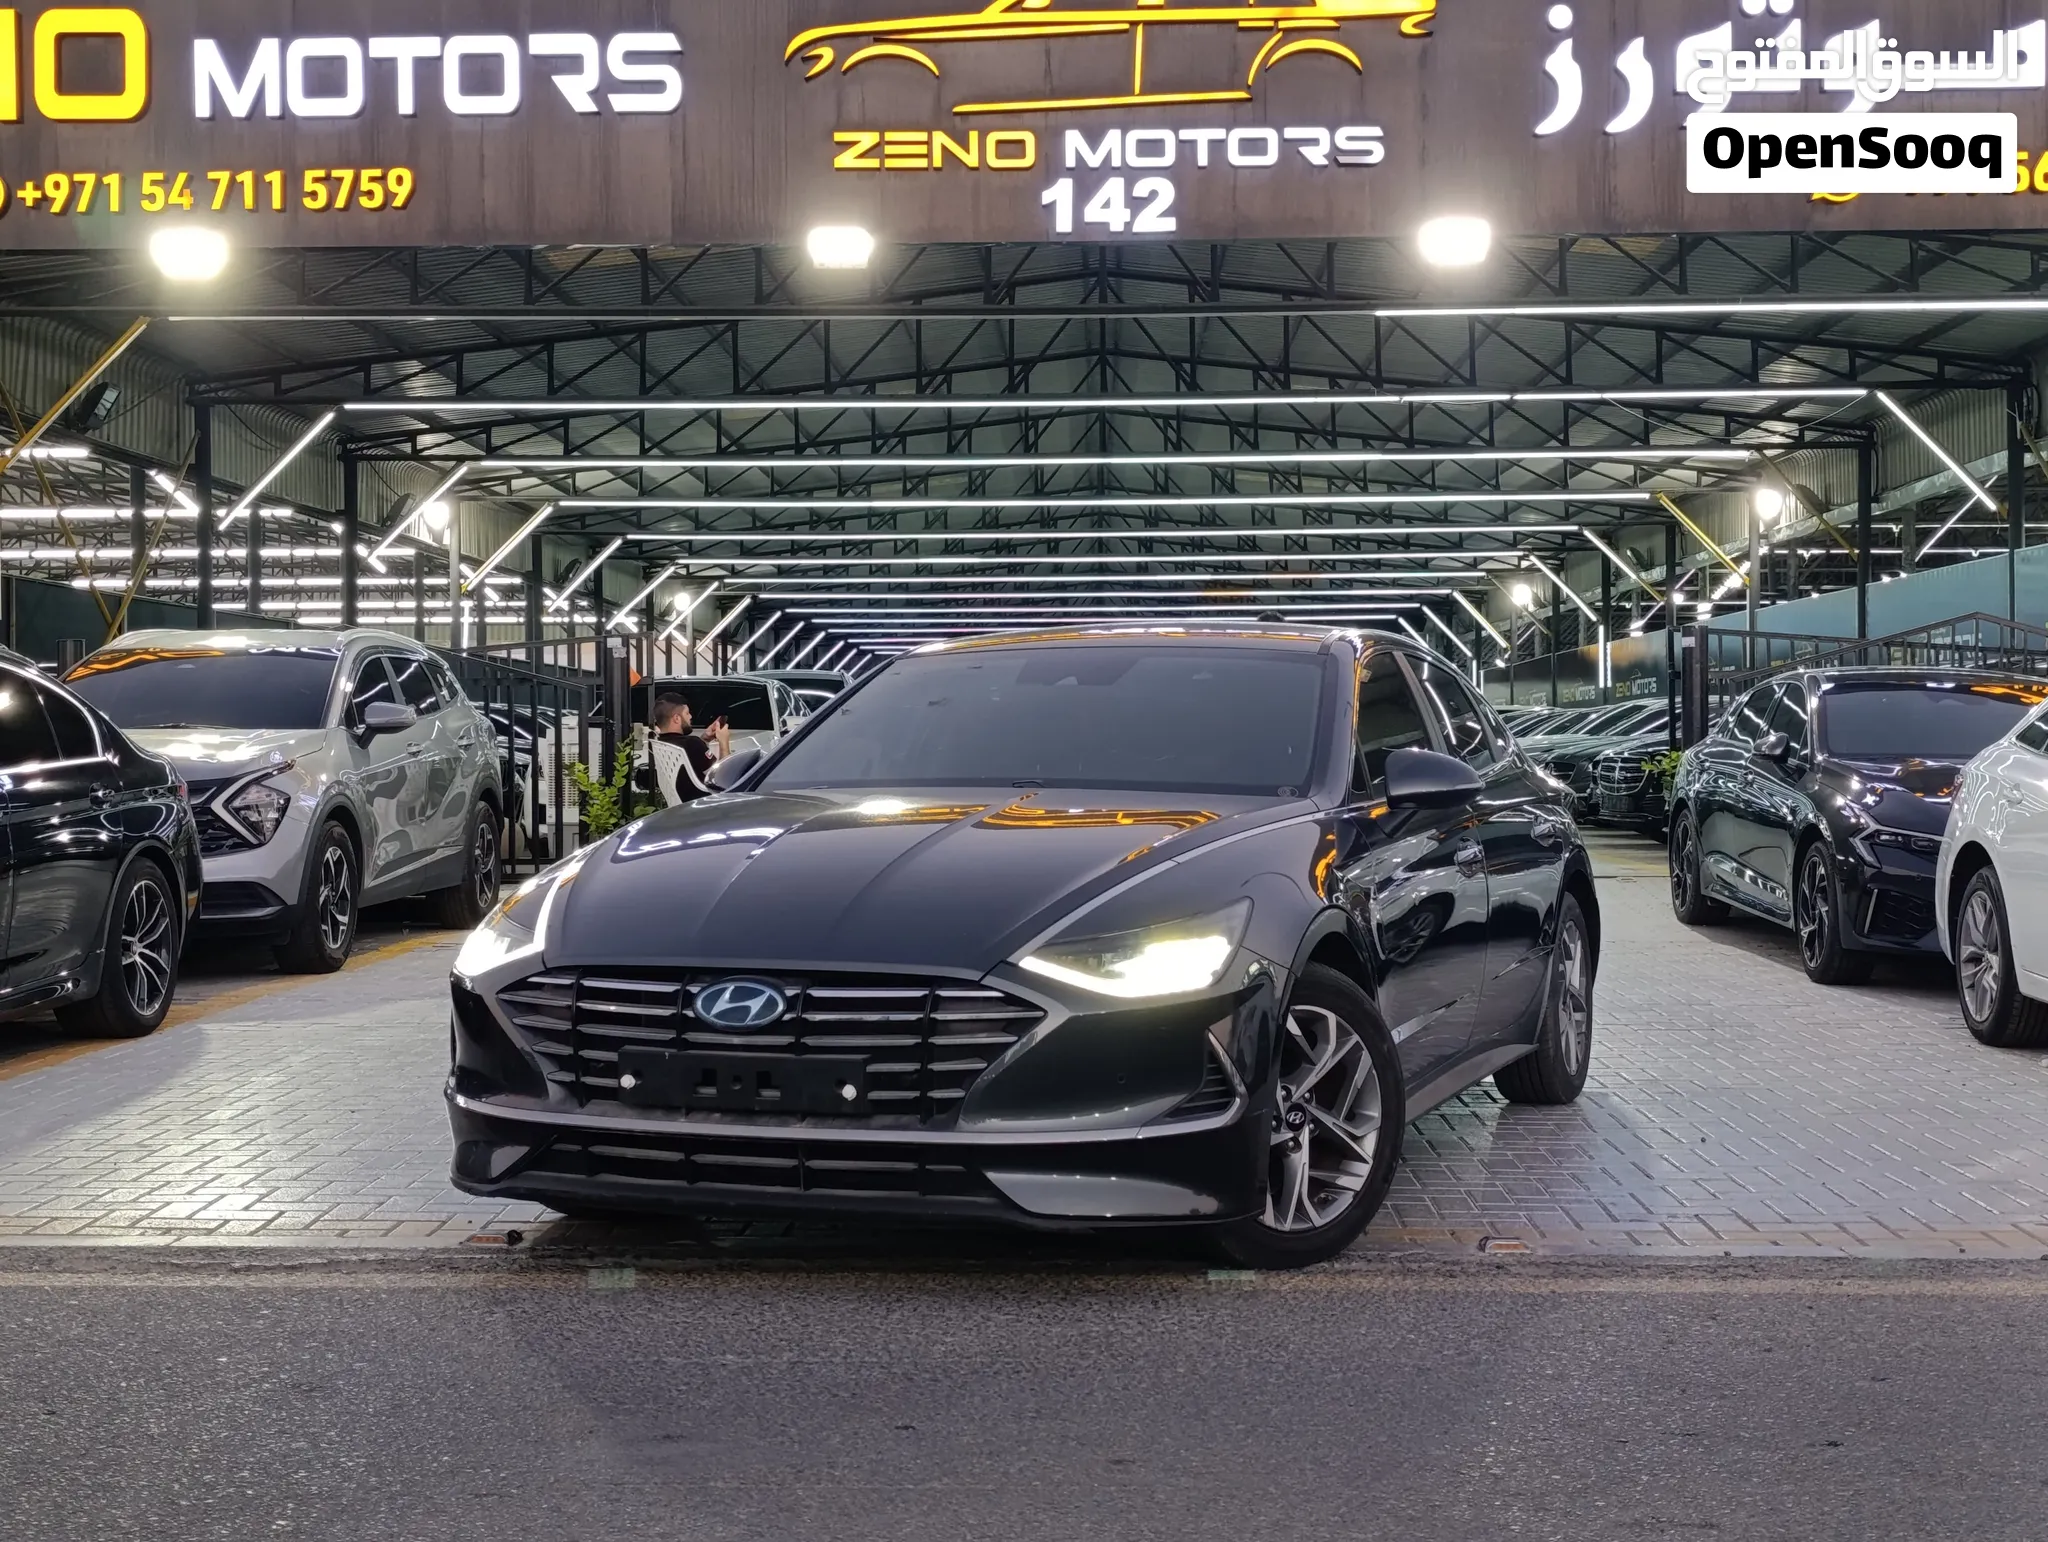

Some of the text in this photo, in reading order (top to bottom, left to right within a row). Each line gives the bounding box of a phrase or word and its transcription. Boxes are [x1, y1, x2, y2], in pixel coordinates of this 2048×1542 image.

[193, 32, 683, 118] MOTORS
[833, 126, 1385, 168] ZENO MOTORS
[16, 167, 413, 213] +971 54 711 5759
[1041, 176, 1177, 233] 142
[1631, 677, 1657, 696] MOTORS
